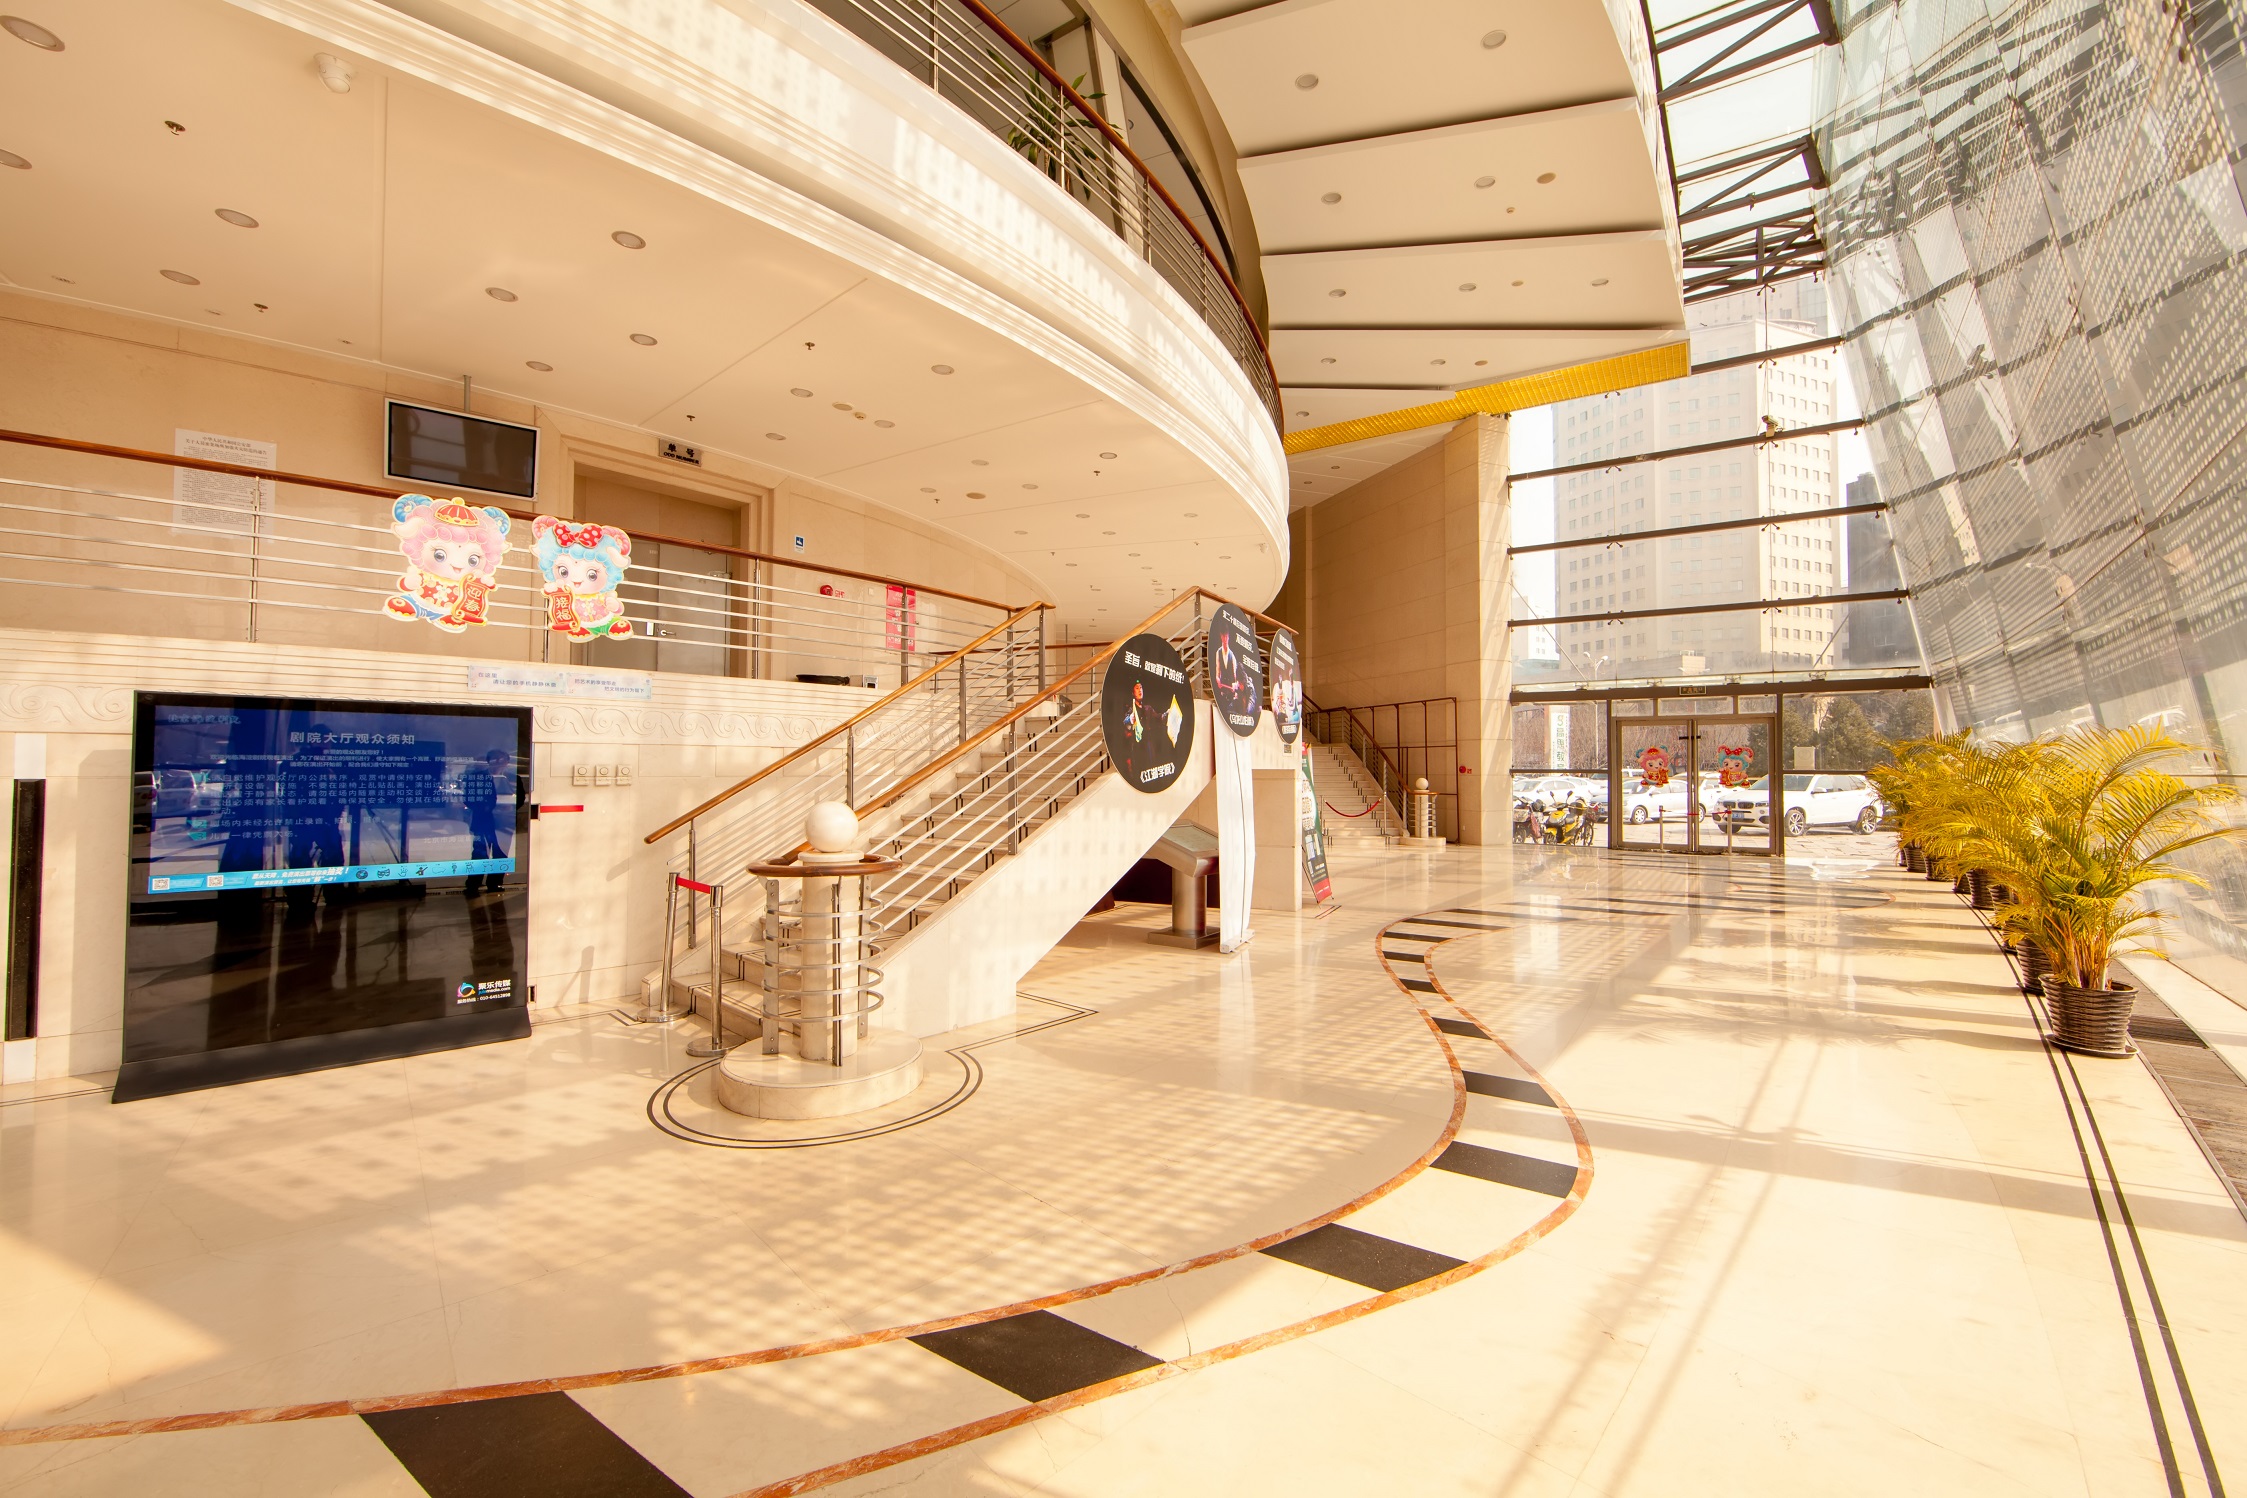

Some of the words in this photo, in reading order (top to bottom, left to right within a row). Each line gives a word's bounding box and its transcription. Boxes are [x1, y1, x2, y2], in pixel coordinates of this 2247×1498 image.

[668, 443, 694, 457] 单号
[464, 586, 482, 612] 迎春
[555, 597, 571, 620] 接福
[290, 731, 415, 745] 剧院大厅观众须知
